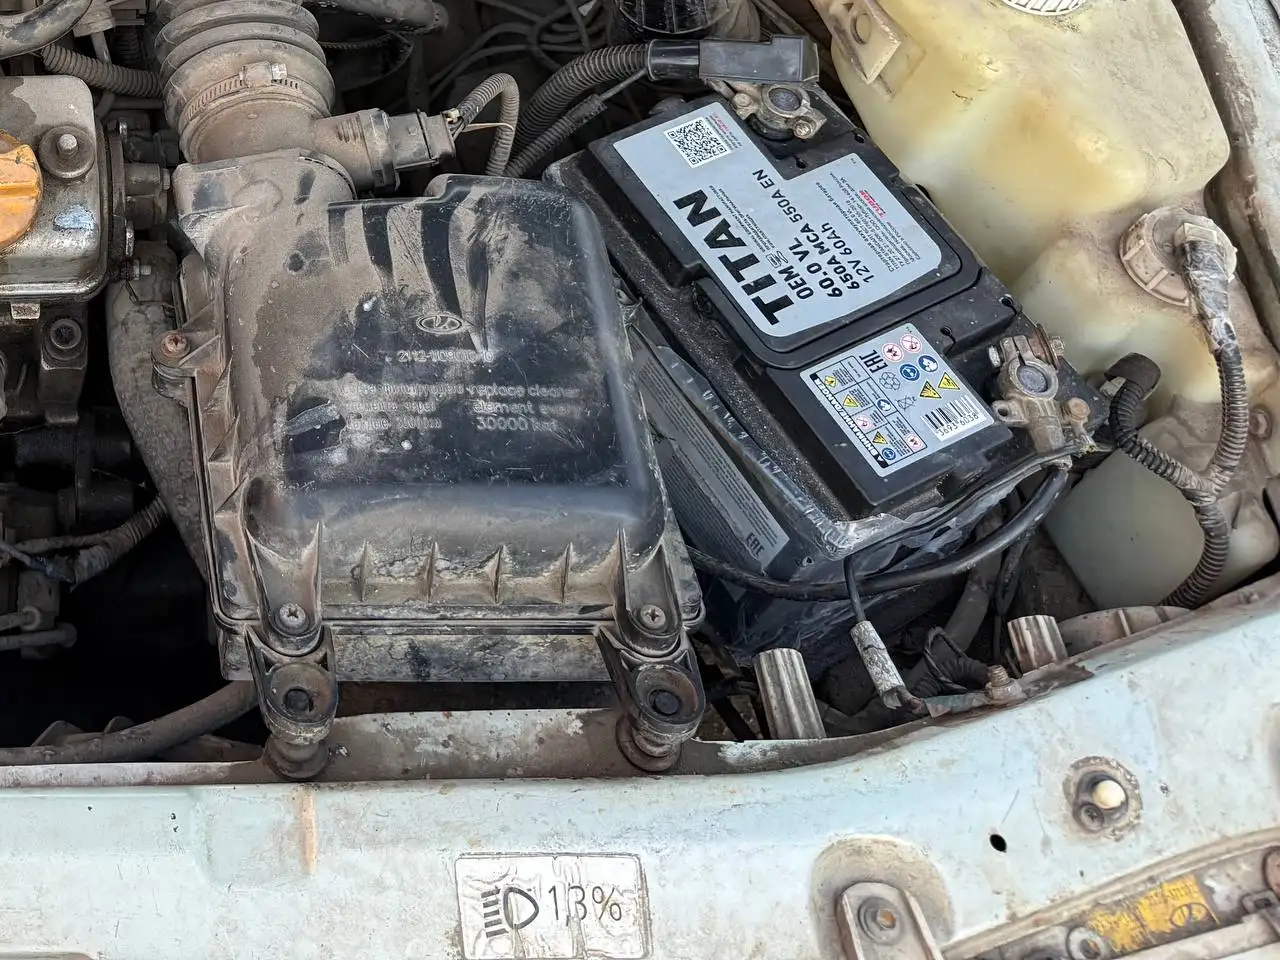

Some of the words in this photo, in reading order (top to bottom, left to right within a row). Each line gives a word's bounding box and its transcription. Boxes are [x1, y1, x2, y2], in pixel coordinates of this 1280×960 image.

[751, 168, 775, 188] EN
[768, 189, 803, 223] 550A
[784, 237, 811, 261] VL
[796, 222, 830, 255] MCA
[817, 221, 853, 257] 60Ah
[672, 188, 794, 325] TITAN
[847, 257, 875, 282] 12V
[866, 241, 895, 272] Стартерная
[778, 265, 815, 300] OEM
[804, 261, 843, 299] 60.0
[824, 254, 861, 291] 650A
[858, 348, 888, 373] EAC
[468, 383, 525, 398] replace
[472, 399, 535, 414] element
[476, 416, 529, 431] 30000
